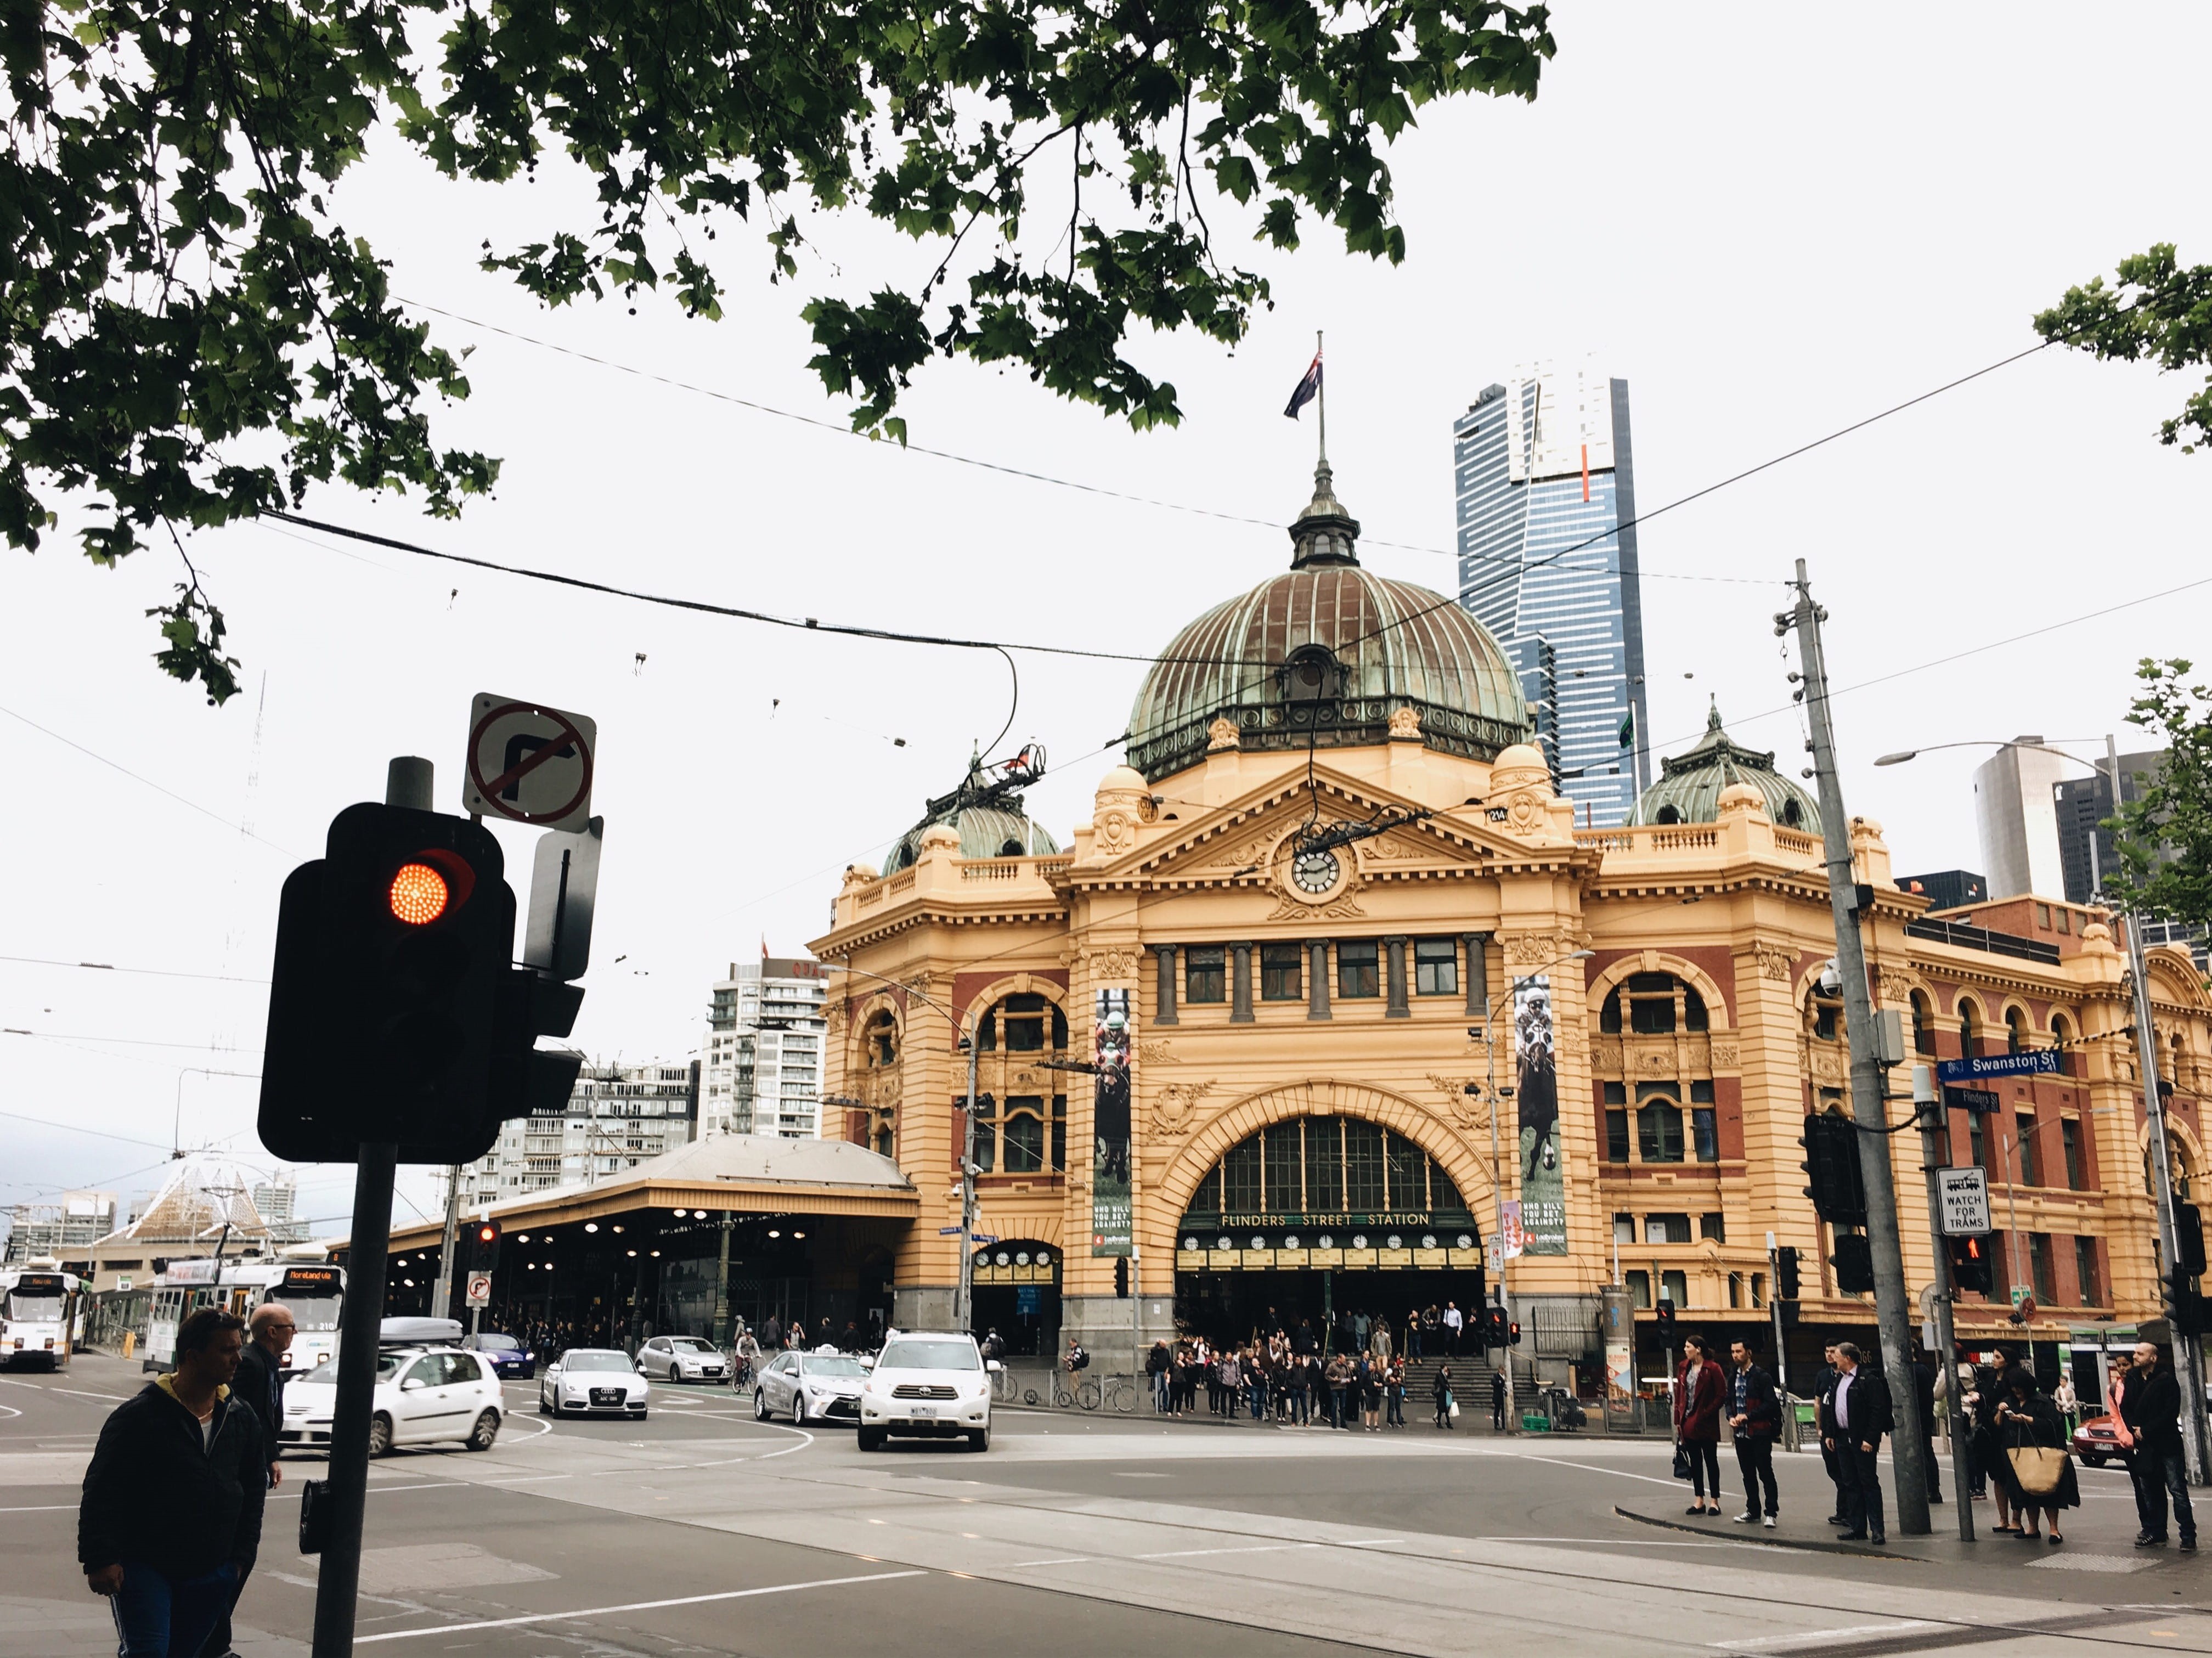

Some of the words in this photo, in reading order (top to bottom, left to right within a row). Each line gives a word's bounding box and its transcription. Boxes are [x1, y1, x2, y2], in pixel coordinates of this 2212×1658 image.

[1490, 810, 1505, 821] 214
[1973, 1055, 2037, 1072] Swanston
[2041, 1051, 2055, 1065] St
[1963, 1090, 1989, 1106] Flinders
[1990, 1094, 1999, 1106] St
[1947, 1195, 1982, 1206] WATCH
[1956, 1207, 1976, 1216] FOR
[1222, 1215, 1285, 1227] FLINDERS
[1303, 1214, 1352, 1226] STREET
[1368, 1213, 1429, 1226] STATION
[1950, 1218, 1984, 1228] TRAMS
[1503, 1213, 1513, 1251] DIWALI
[290, 1271, 320, 1279] Moreland
[319, 1322, 334, 1330] 210
